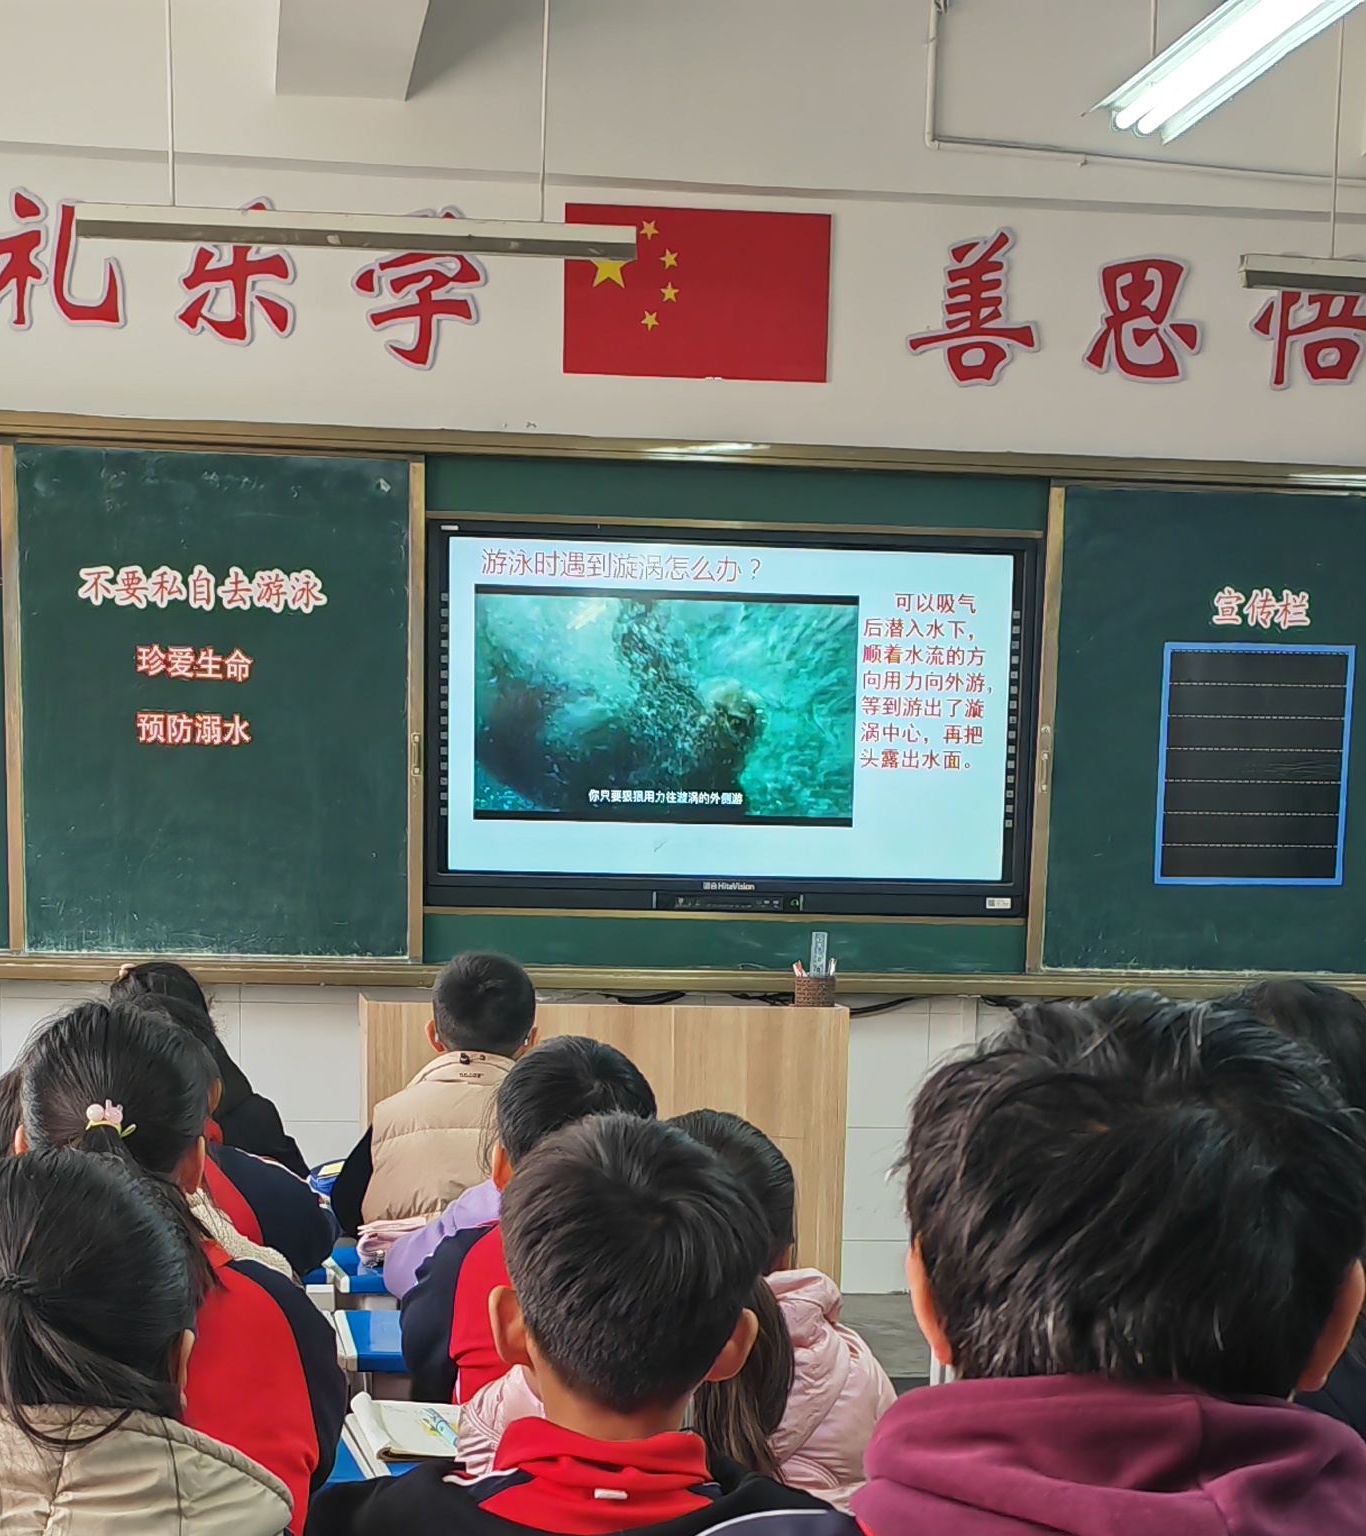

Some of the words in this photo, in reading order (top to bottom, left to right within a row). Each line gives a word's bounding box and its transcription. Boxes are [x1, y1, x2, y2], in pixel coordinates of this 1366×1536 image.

[481, 547, 761, 583] 游泳时遇到漩涡怎么办？
[79, 566, 327, 612] 不要私自去游泳
[895, 593, 976, 614] 可以吸气
[1212, 586, 1311, 628] 宣传栏
[863, 618, 975, 641] 后潜入水下，
[136, 644, 253, 682] 珍爱生命
[862, 644, 986, 667] 顺着水流的方
[862, 670, 993, 695] 向用力向外游，
[861, 695, 985, 719] 等到游出了漩
[136, 712, 252, 745] 预防溺水
[860, 721, 984, 745] 涡中心，再把
[859, 748, 972, 770] 头露出水面。
